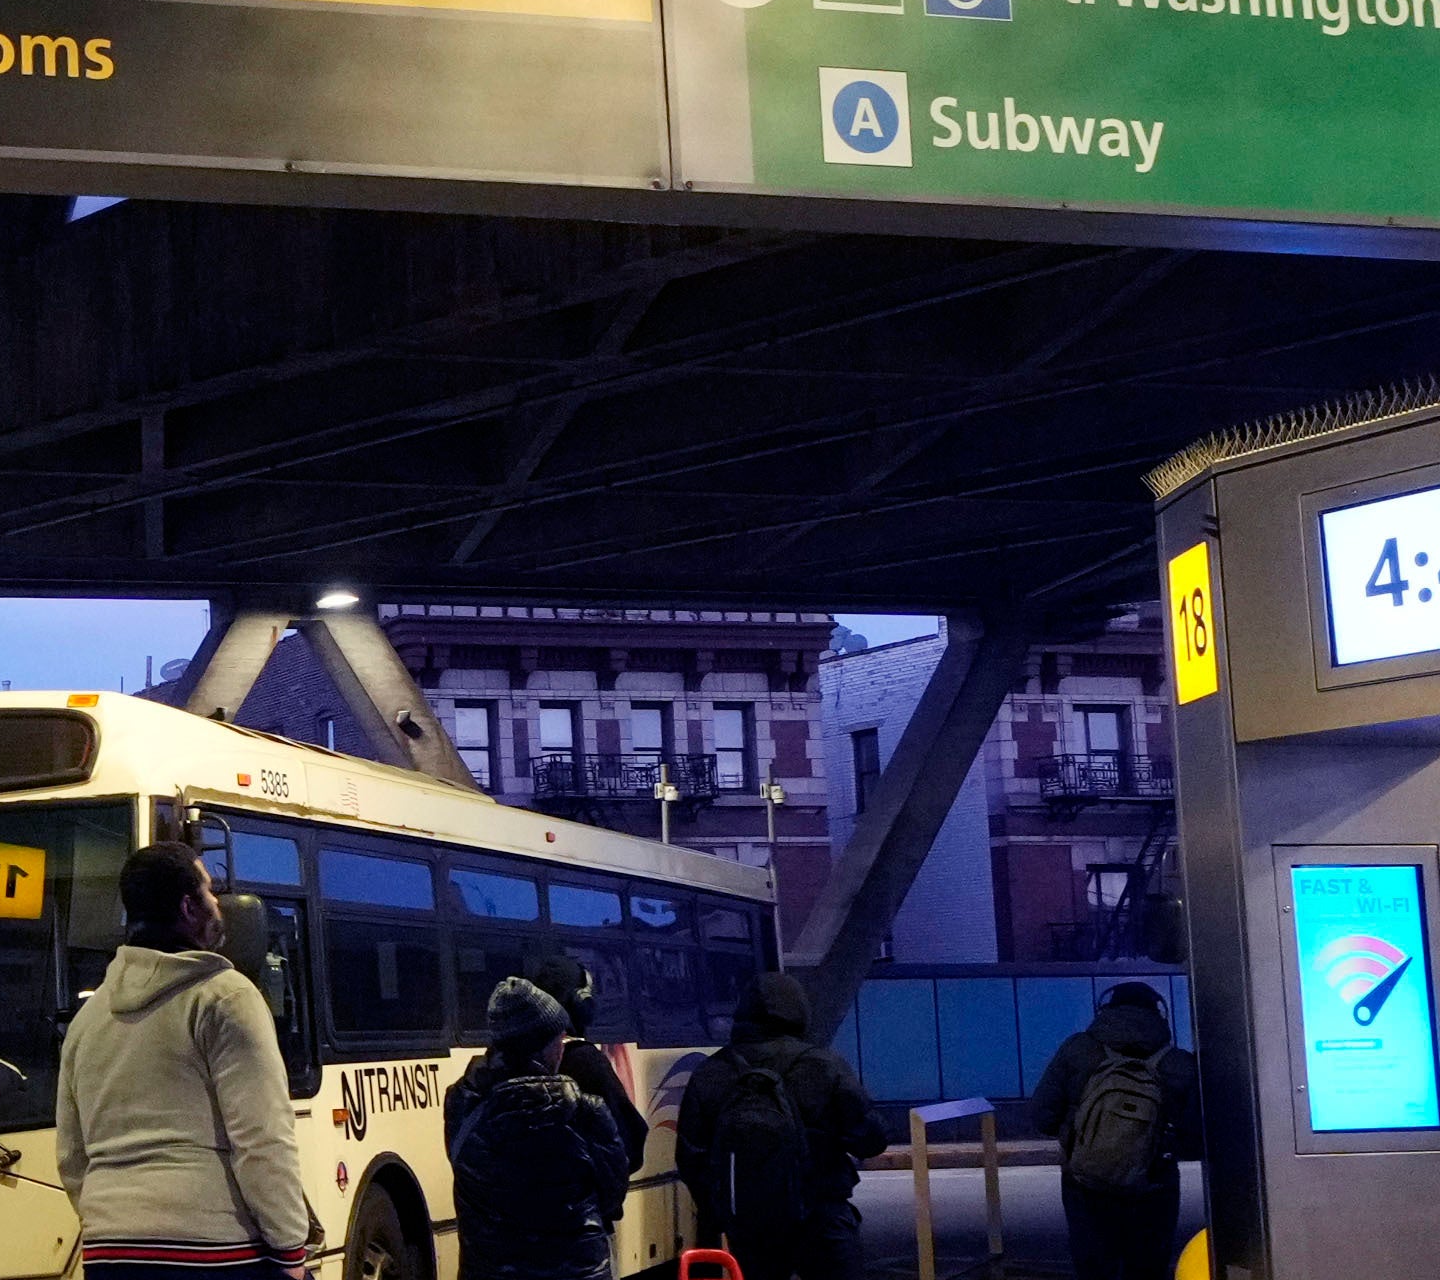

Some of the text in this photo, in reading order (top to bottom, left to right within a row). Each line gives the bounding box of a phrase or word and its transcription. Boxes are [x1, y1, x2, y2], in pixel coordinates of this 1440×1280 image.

[848, 96, 884, 140] A
[930, 97, 1165, 175] Subway
[1179, 587, 1207, 662] 18
[260, 769, 289, 799] 5385
[1300, 878, 1373, 895] FAST &
[1357, 897, 1410, 914] WI-FI
[365, 1063, 441, 1114] TRANSIT
